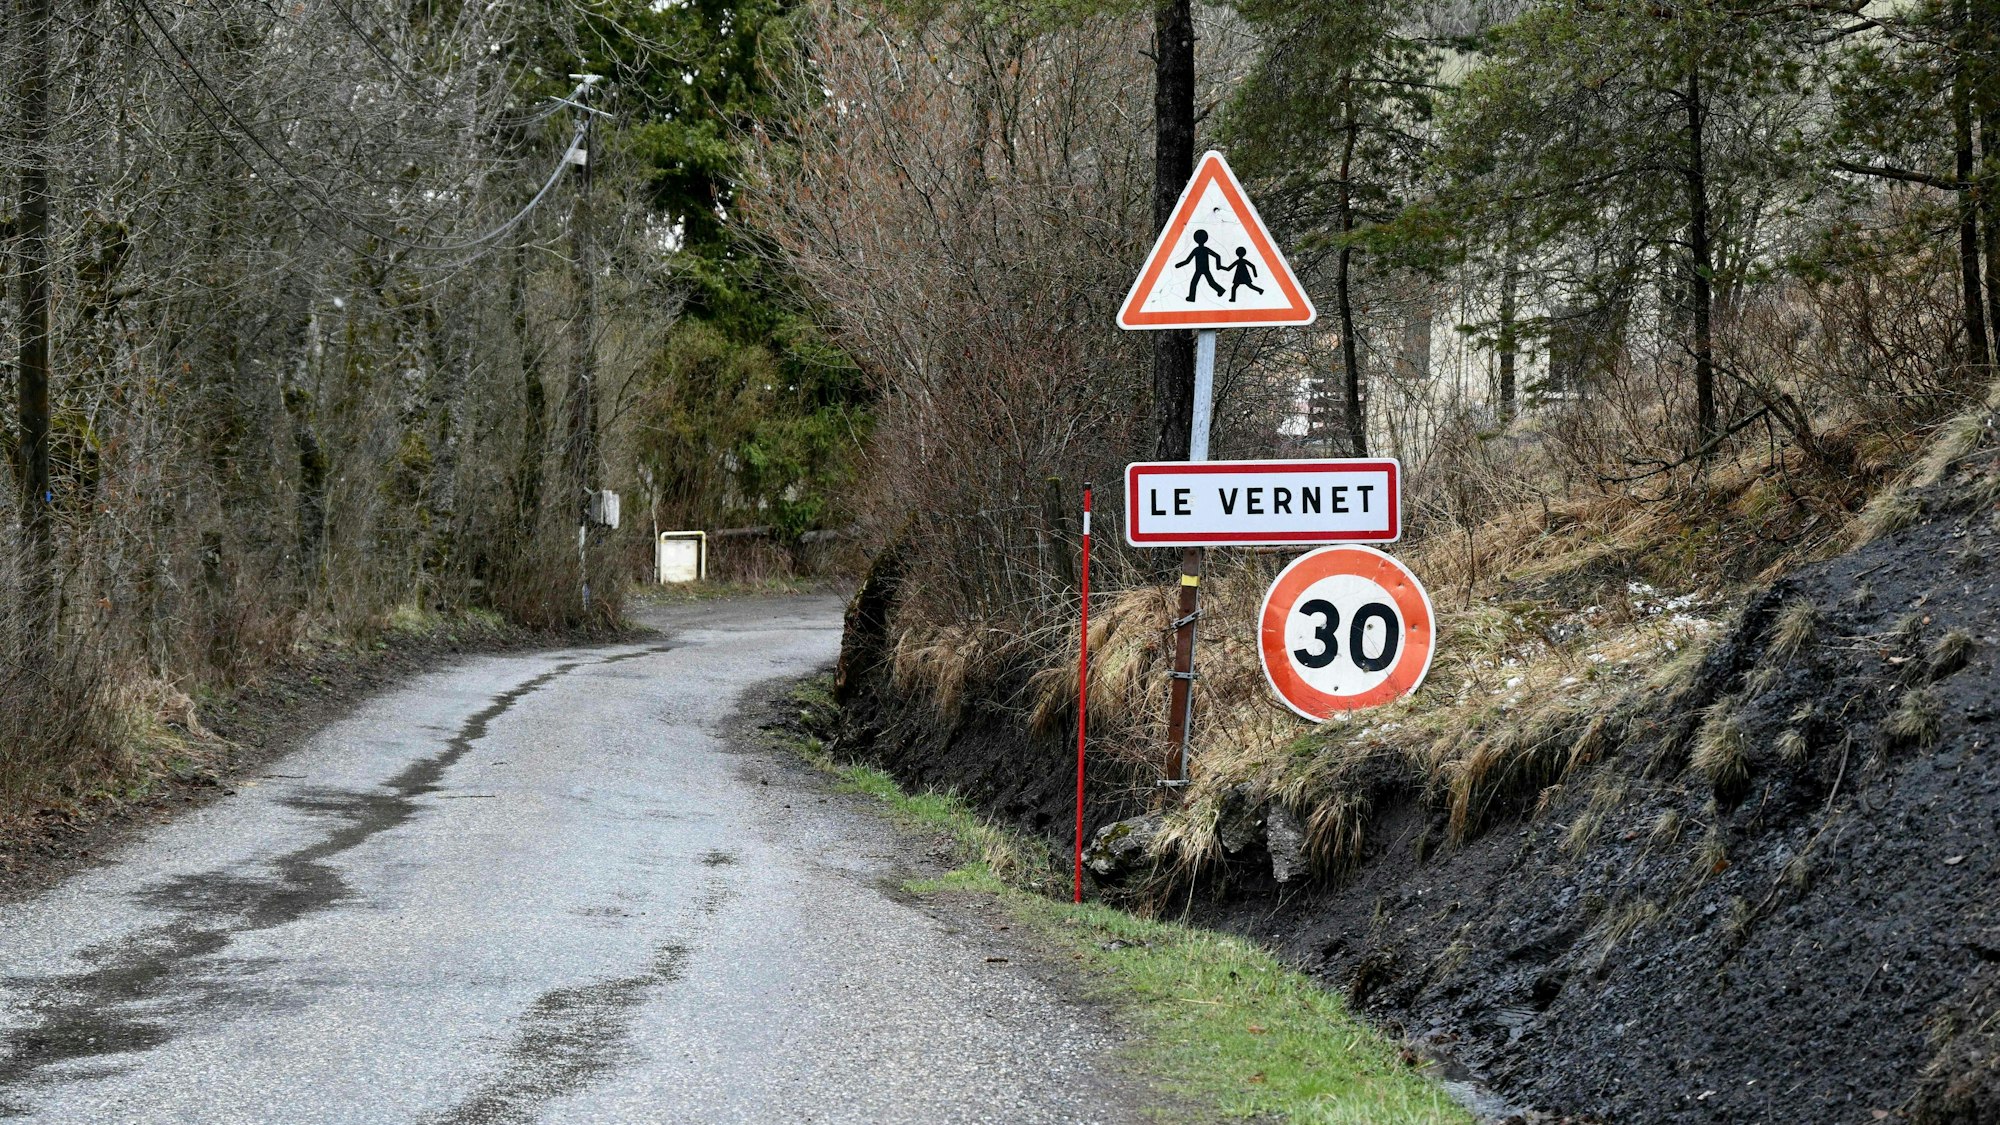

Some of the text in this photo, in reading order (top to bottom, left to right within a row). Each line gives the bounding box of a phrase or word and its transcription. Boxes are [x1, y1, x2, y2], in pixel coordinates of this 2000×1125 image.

[1150, 485, 1374, 516] LE VERNET
[1293, 598, 1400, 672] 30
